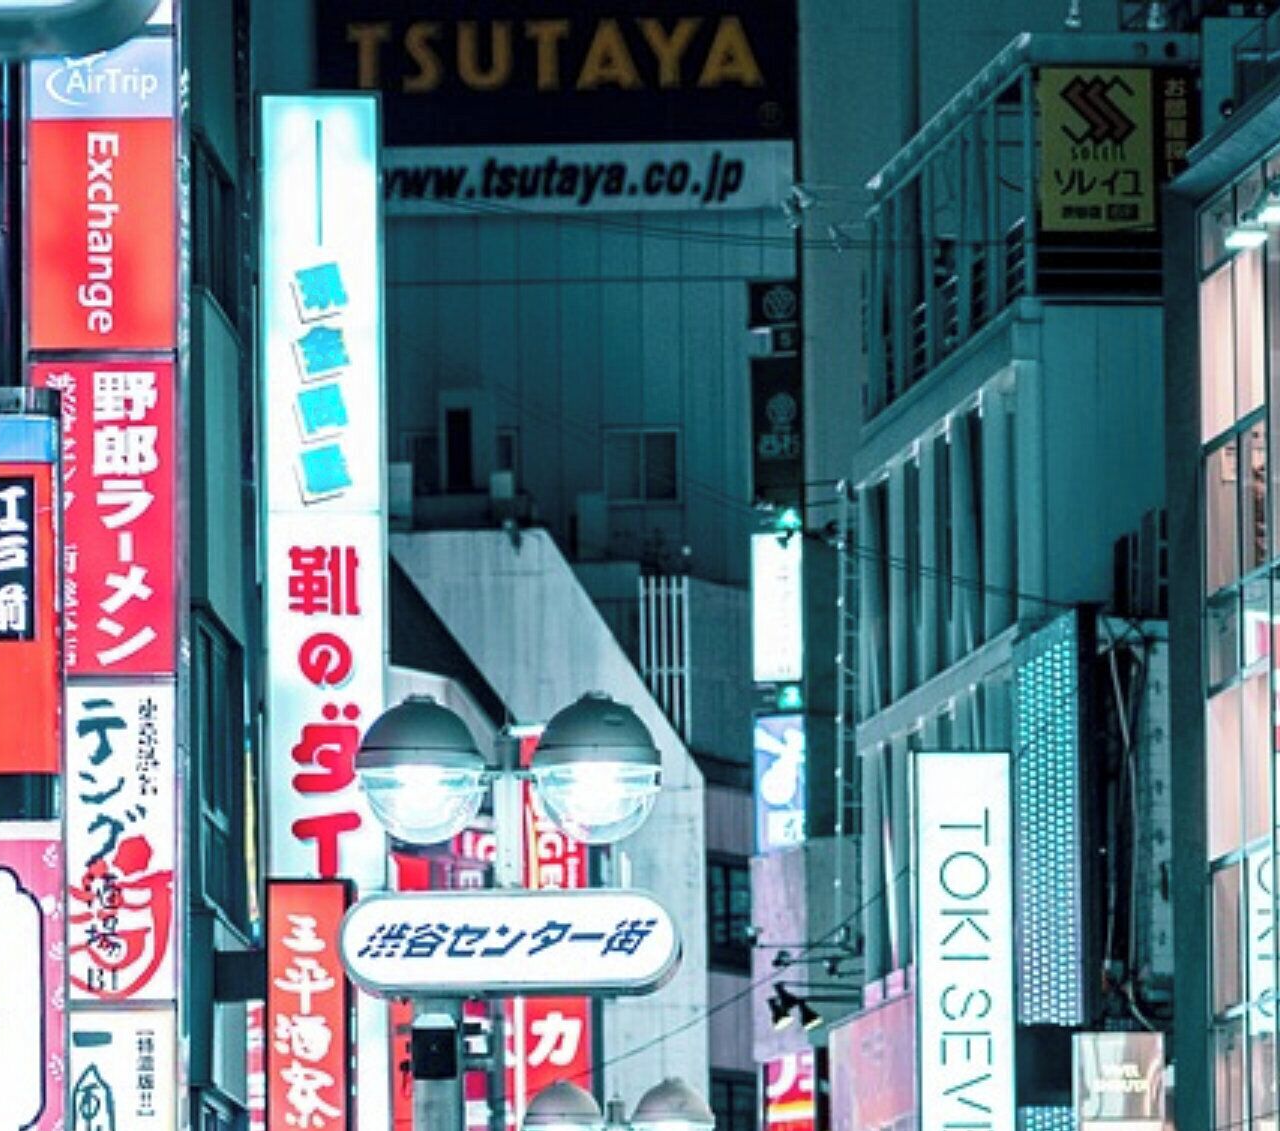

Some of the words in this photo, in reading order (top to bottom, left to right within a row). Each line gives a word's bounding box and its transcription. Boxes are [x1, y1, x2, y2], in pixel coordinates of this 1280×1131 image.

[66, 68, 158, 99] AirTrip
[347, 16, 764, 92] TSUTAYA
[77, 131, 119, 334] Exchange
[1054, 168, 1143, 196] ソレイユ
[92, 371, 159, 666] 野郎ラーメン
[76, 699, 147, 867] テング
[357, 919, 657, 959] 渋谷センター街
[939, 808, 990, 961] TOKI
